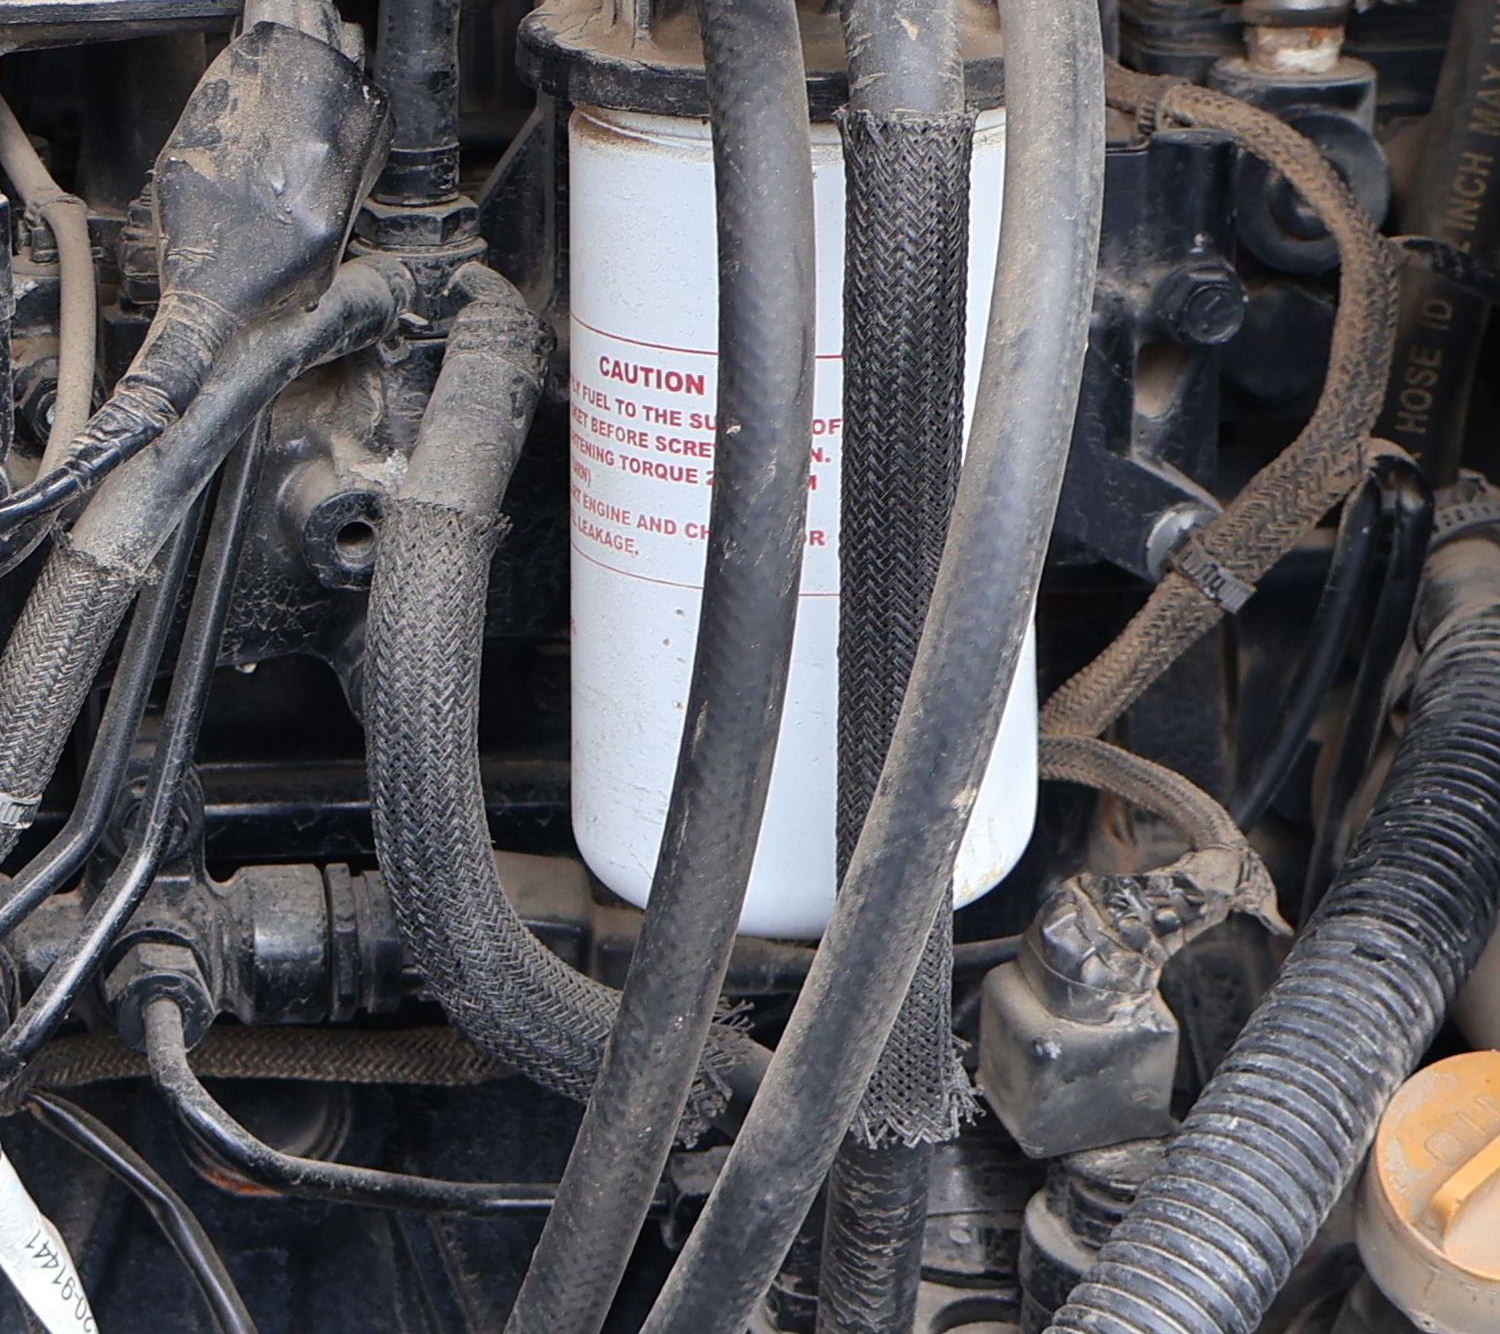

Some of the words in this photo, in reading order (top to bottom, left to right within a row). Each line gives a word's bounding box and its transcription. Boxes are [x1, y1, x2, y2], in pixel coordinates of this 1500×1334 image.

[1450, 148, 1494, 231] INCH
[599, 355, 705, 395] CAUTION
[1396, 344, 1445, 436] HOSE
[1421, 295, 1455, 331] ID
[582, 385, 610, 411] FUEL
[615, 398, 637, 418] TO
[642, 405, 682, 427] THE
[811, 418, 842, 435] OF
[591, 417, 649, 448] BEFORE
[620, 454, 698, 484] TORQUE
[578, 516, 640, 555] LEAKAGE.
[583, 496, 631, 526] ENGINE
[637, 514, 677, 536] AND
